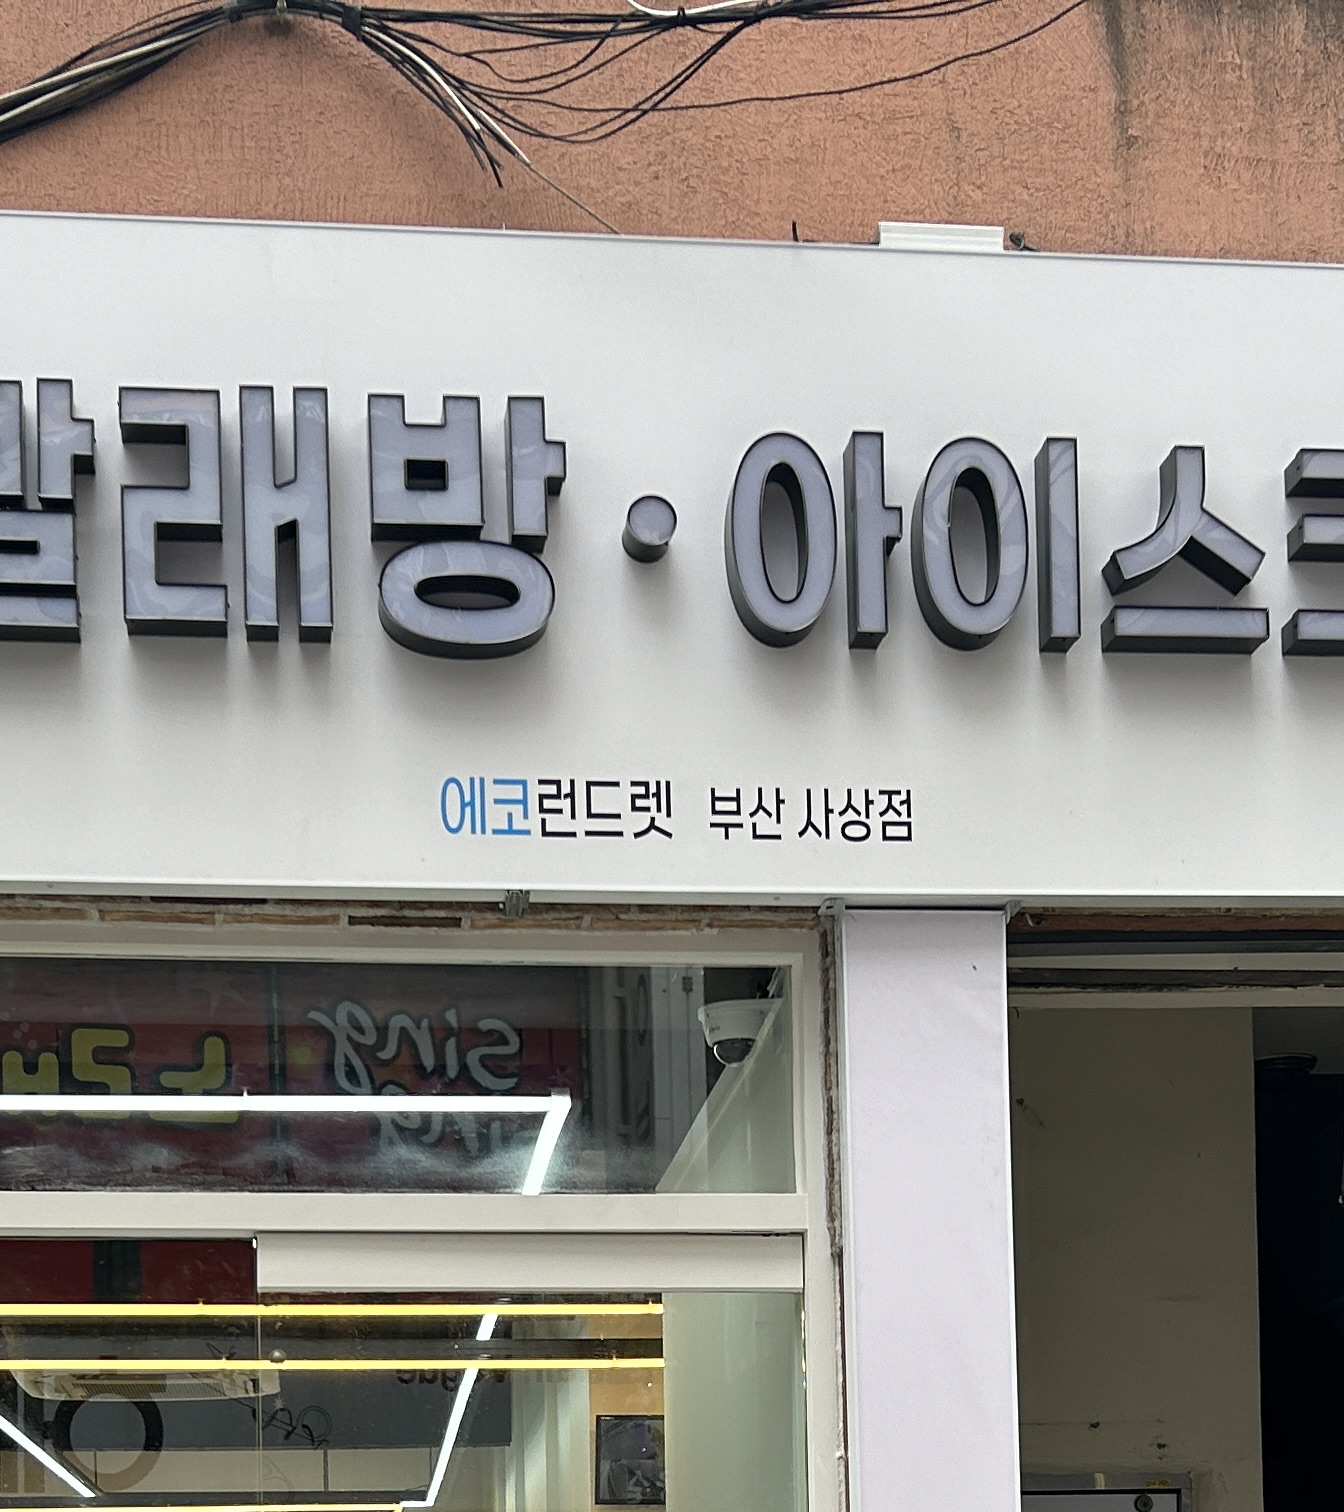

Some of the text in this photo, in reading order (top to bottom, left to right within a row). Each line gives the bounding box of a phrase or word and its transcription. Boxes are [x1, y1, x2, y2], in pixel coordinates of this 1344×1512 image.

[440, 775, 914, 844] 에코런드렛 부산 사상점
